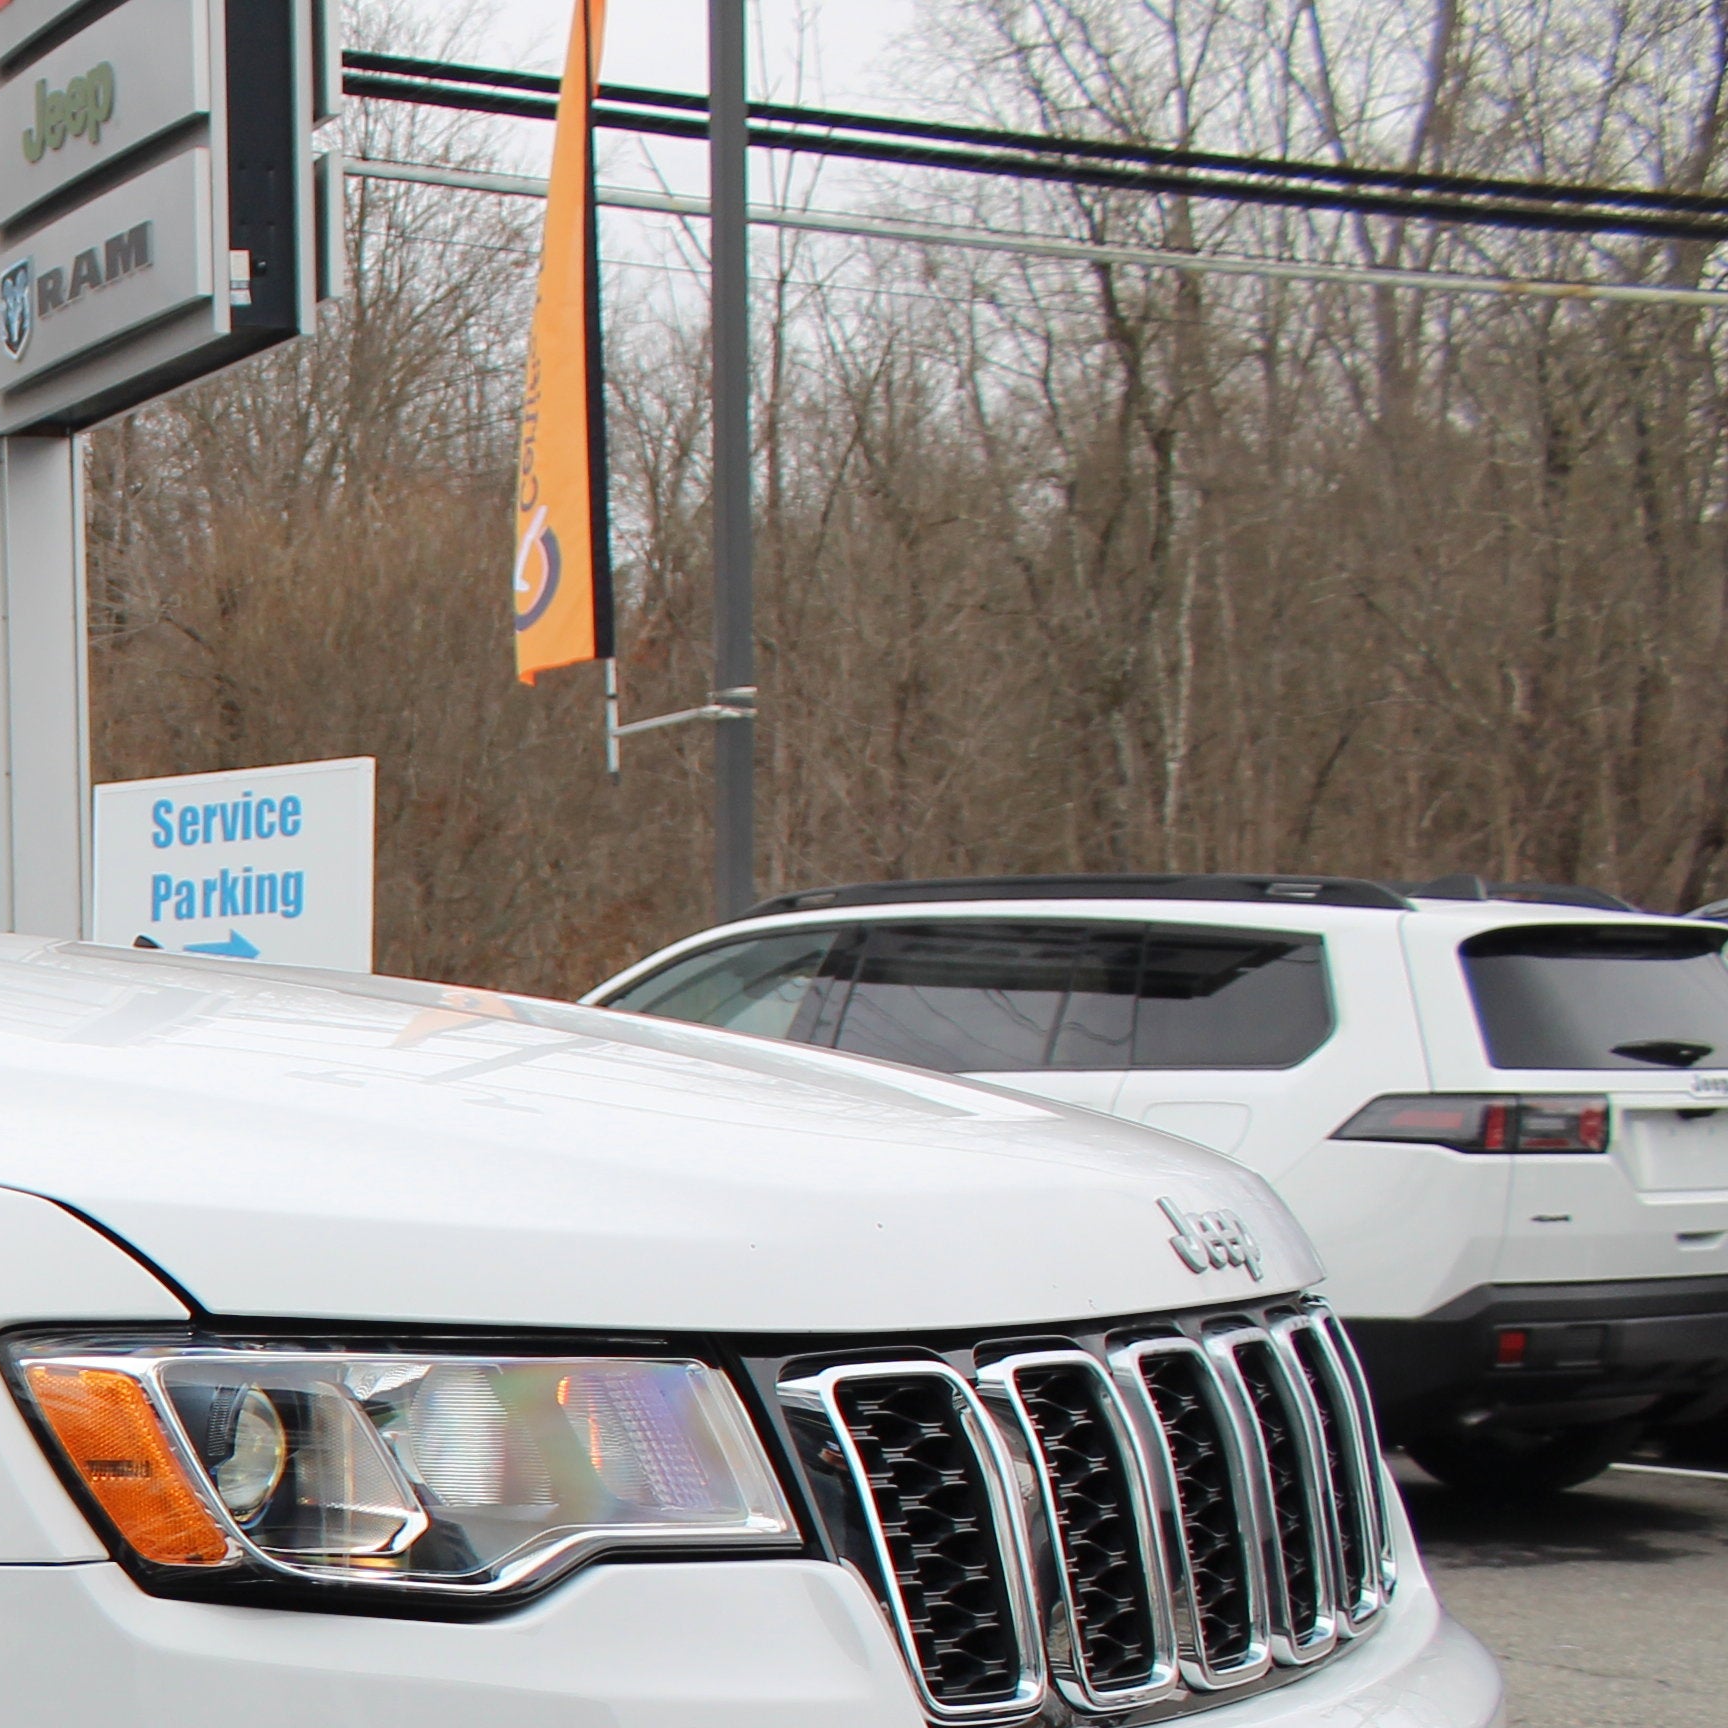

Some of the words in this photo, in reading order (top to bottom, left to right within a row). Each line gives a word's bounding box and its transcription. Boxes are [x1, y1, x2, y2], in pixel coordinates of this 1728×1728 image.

[22, 60, 114, 162] Jeep
[37, 220, 152, 318] RAM
[152, 791, 302, 848] Service
[152, 866, 304, 922] Parking
[1155, 1196, 1263, 1282] Jeep
